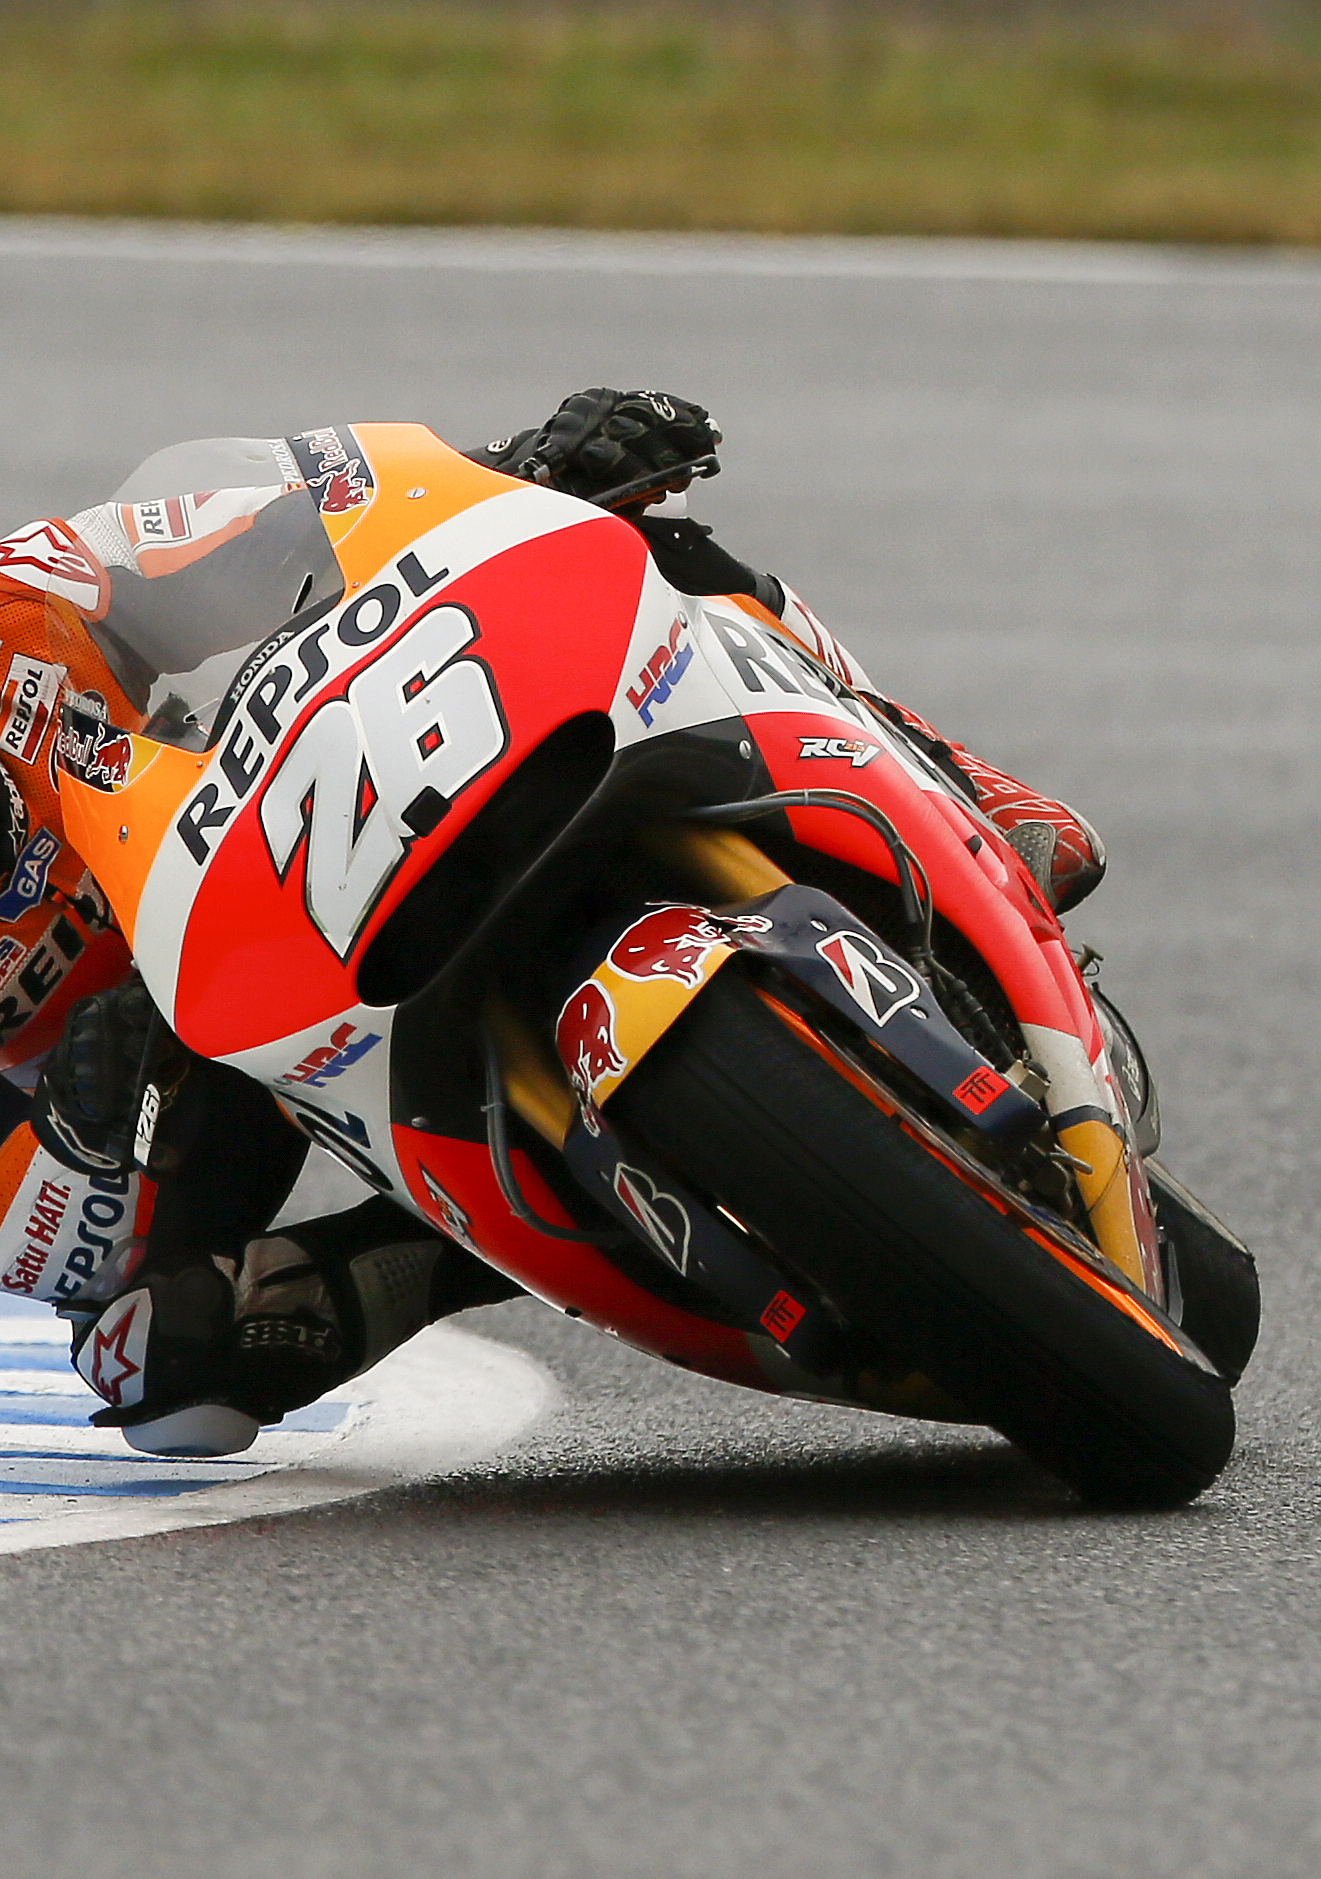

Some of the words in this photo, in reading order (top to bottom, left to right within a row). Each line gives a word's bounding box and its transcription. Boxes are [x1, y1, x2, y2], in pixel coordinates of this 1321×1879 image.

[230, 631, 295, 703] HONDA
[626, 618, 694, 729] HRC
[5, 668, 44, 750] REPSOL
[177, 551, 450, 867] REPSOL
[258, 601, 510, 966] 26
[17, 838, 55, 898] GAS
[282, 1021, 383, 1088] HRC
[2, 1243, 49, 1294] Satu
[52, 1173, 129, 1300] EPSOL
